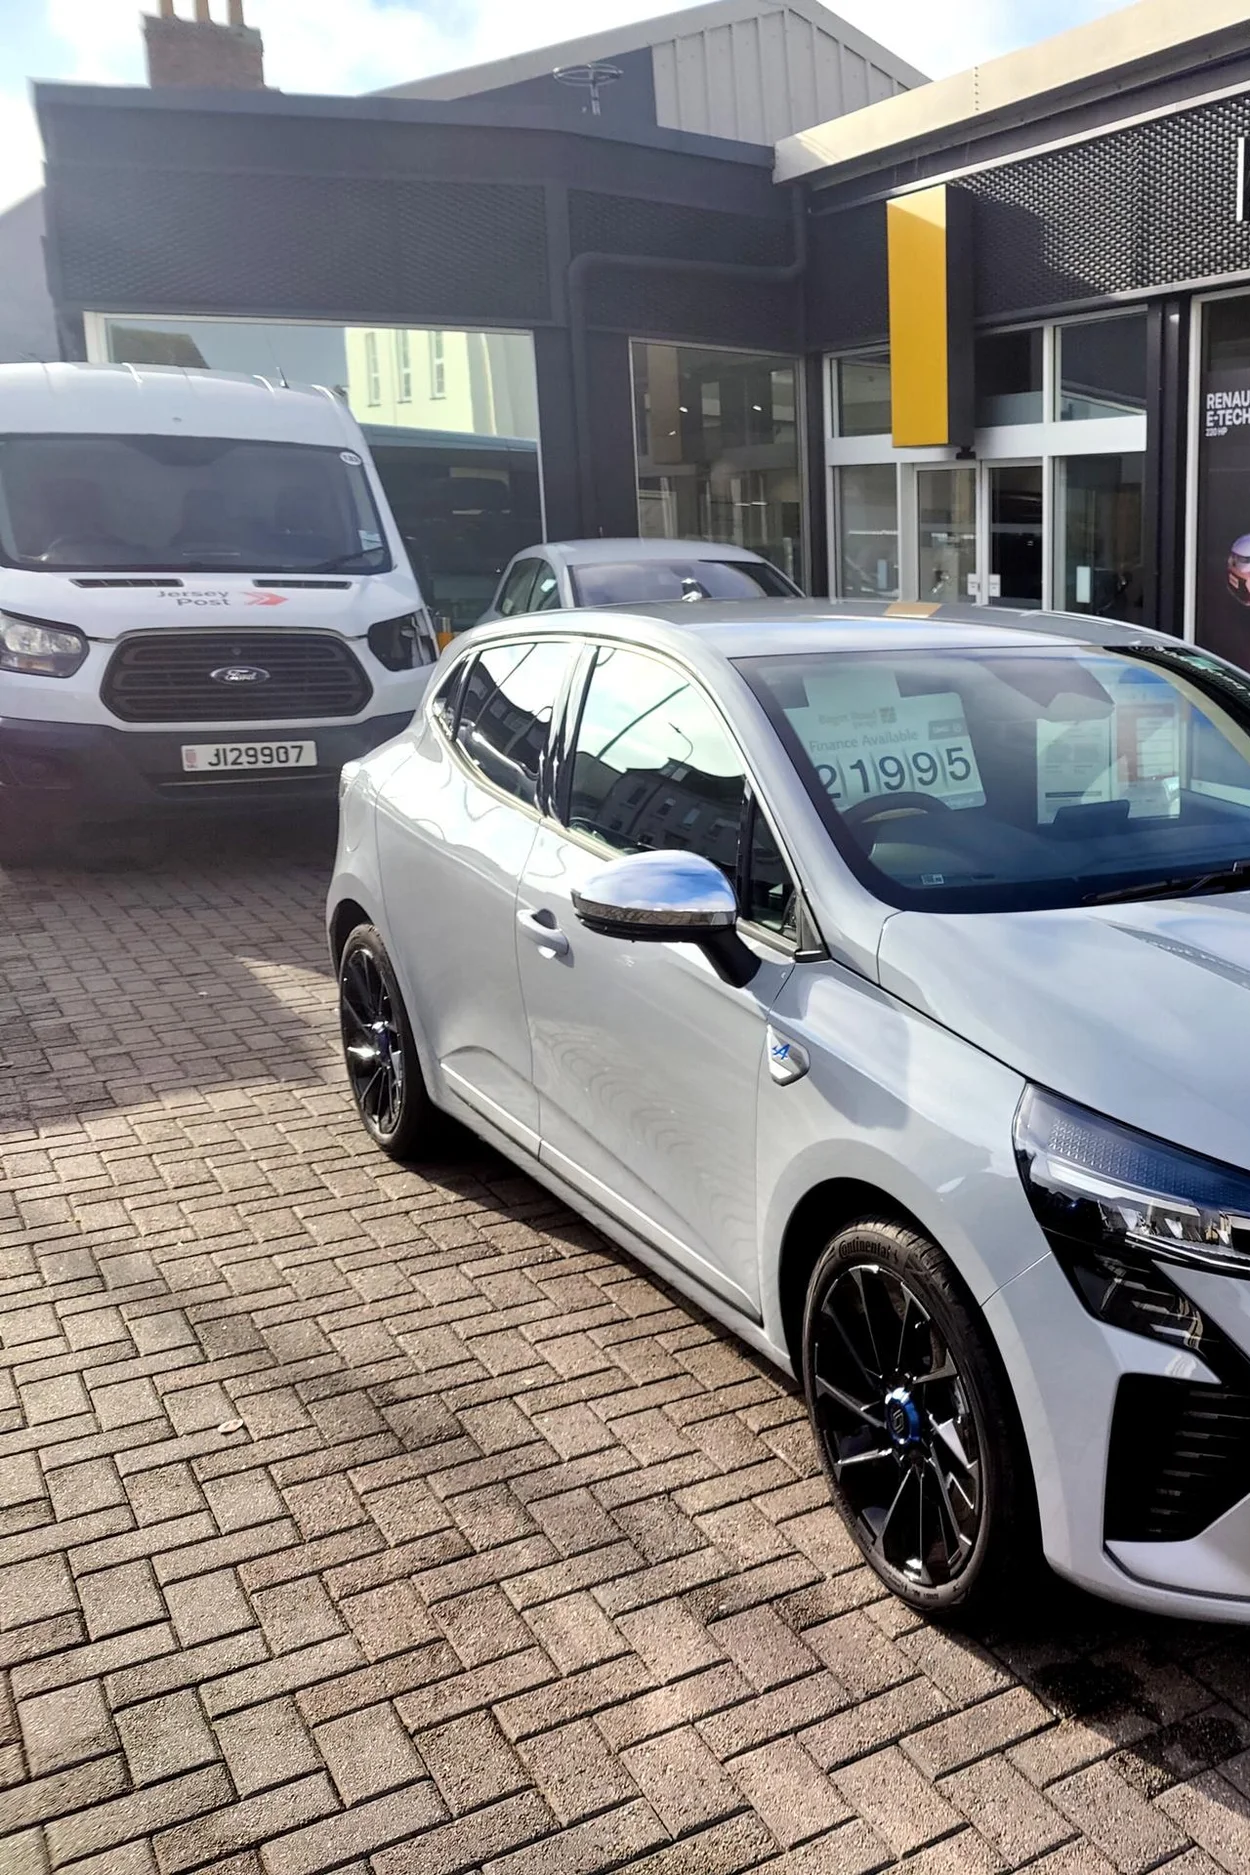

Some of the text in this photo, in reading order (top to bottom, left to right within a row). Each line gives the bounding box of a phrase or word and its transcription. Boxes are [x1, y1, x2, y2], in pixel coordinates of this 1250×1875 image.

[157, 590, 229, 599] Jersey
[176, 598, 231, 606] Post
[225, 669, 258, 681] Ford
[808, 738, 858, 752] Finance
[862, 728, 919, 747] Available
[207, 744, 305, 767] J129907
[815, 747, 971, 799] 21995
[838, 1236, 892, 1260] Continental
